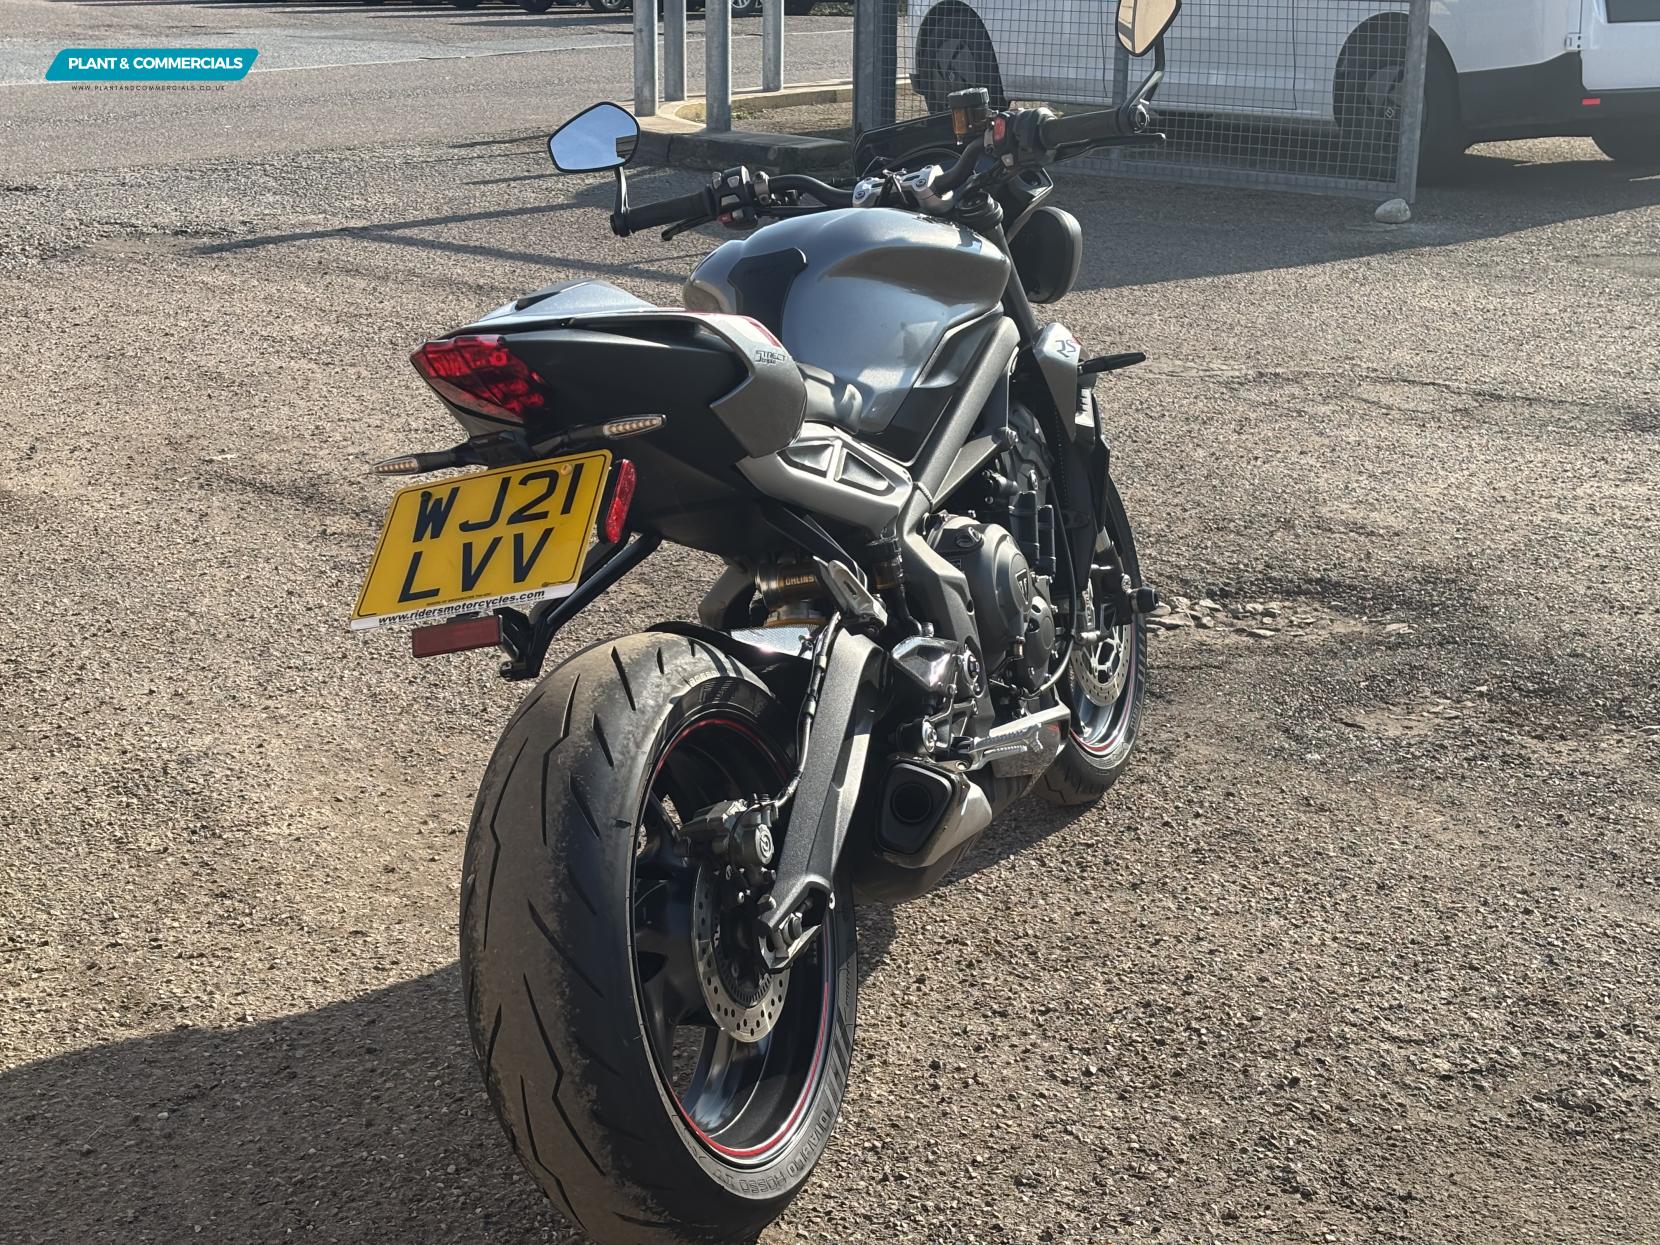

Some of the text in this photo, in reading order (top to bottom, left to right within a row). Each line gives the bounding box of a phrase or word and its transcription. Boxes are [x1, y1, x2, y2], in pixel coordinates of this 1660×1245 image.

[412, 463, 584, 543] WJ21
[398, 528, 554, 604] LVV
[378, 589, 545, 625] www.ridersmotorcycles.com
